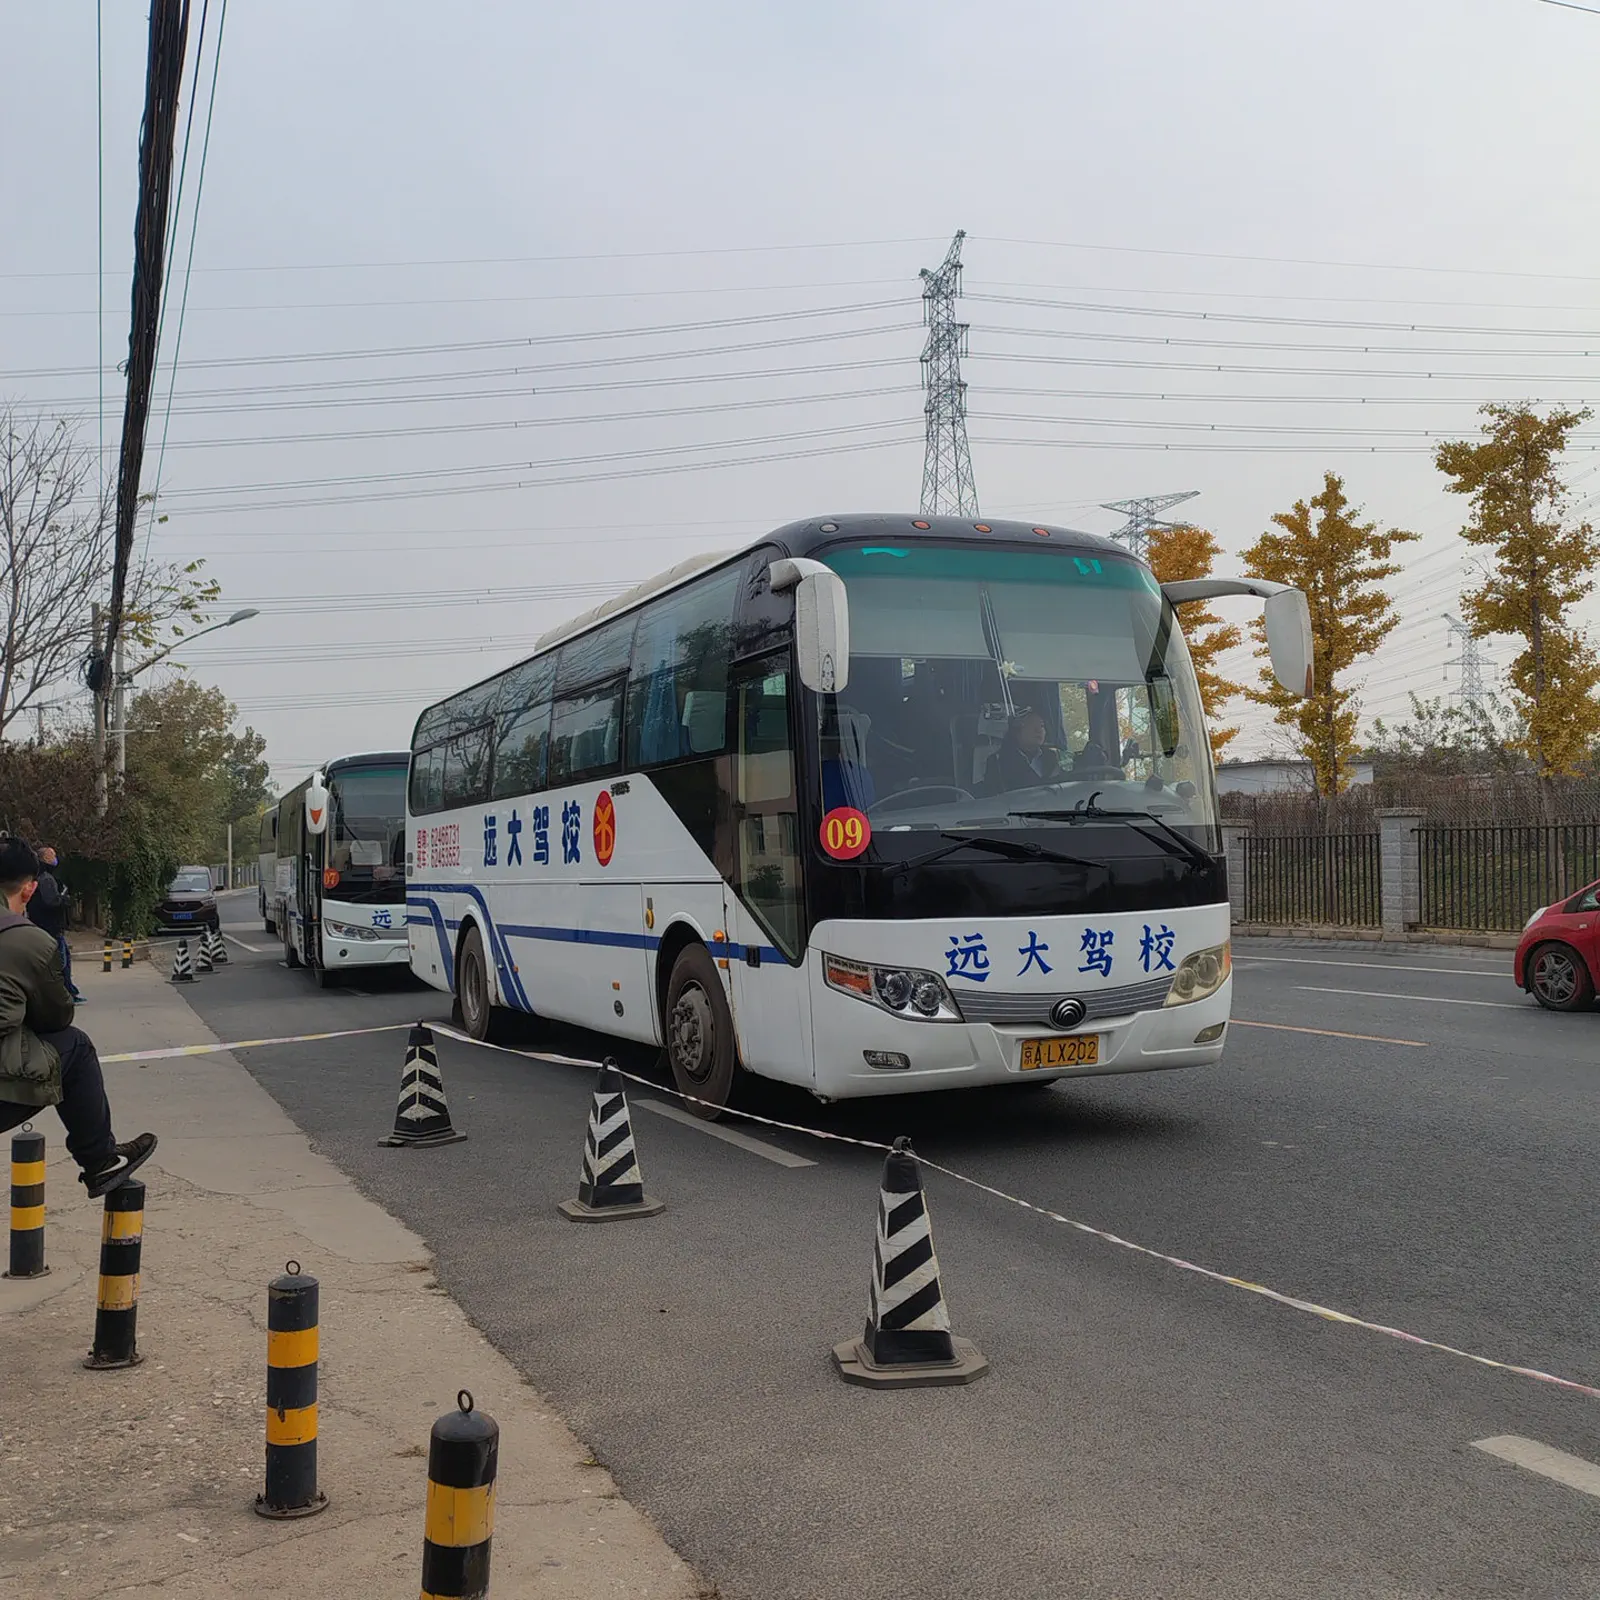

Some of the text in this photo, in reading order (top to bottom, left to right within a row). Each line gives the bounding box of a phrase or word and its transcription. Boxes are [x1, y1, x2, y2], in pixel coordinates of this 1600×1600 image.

[484, 799, 581, 868] 远大驾校
[827, 817, 863, 849] 09
[324, 871, 337, 886] 07
[945, 924, 1177, 982] 远大驾校
